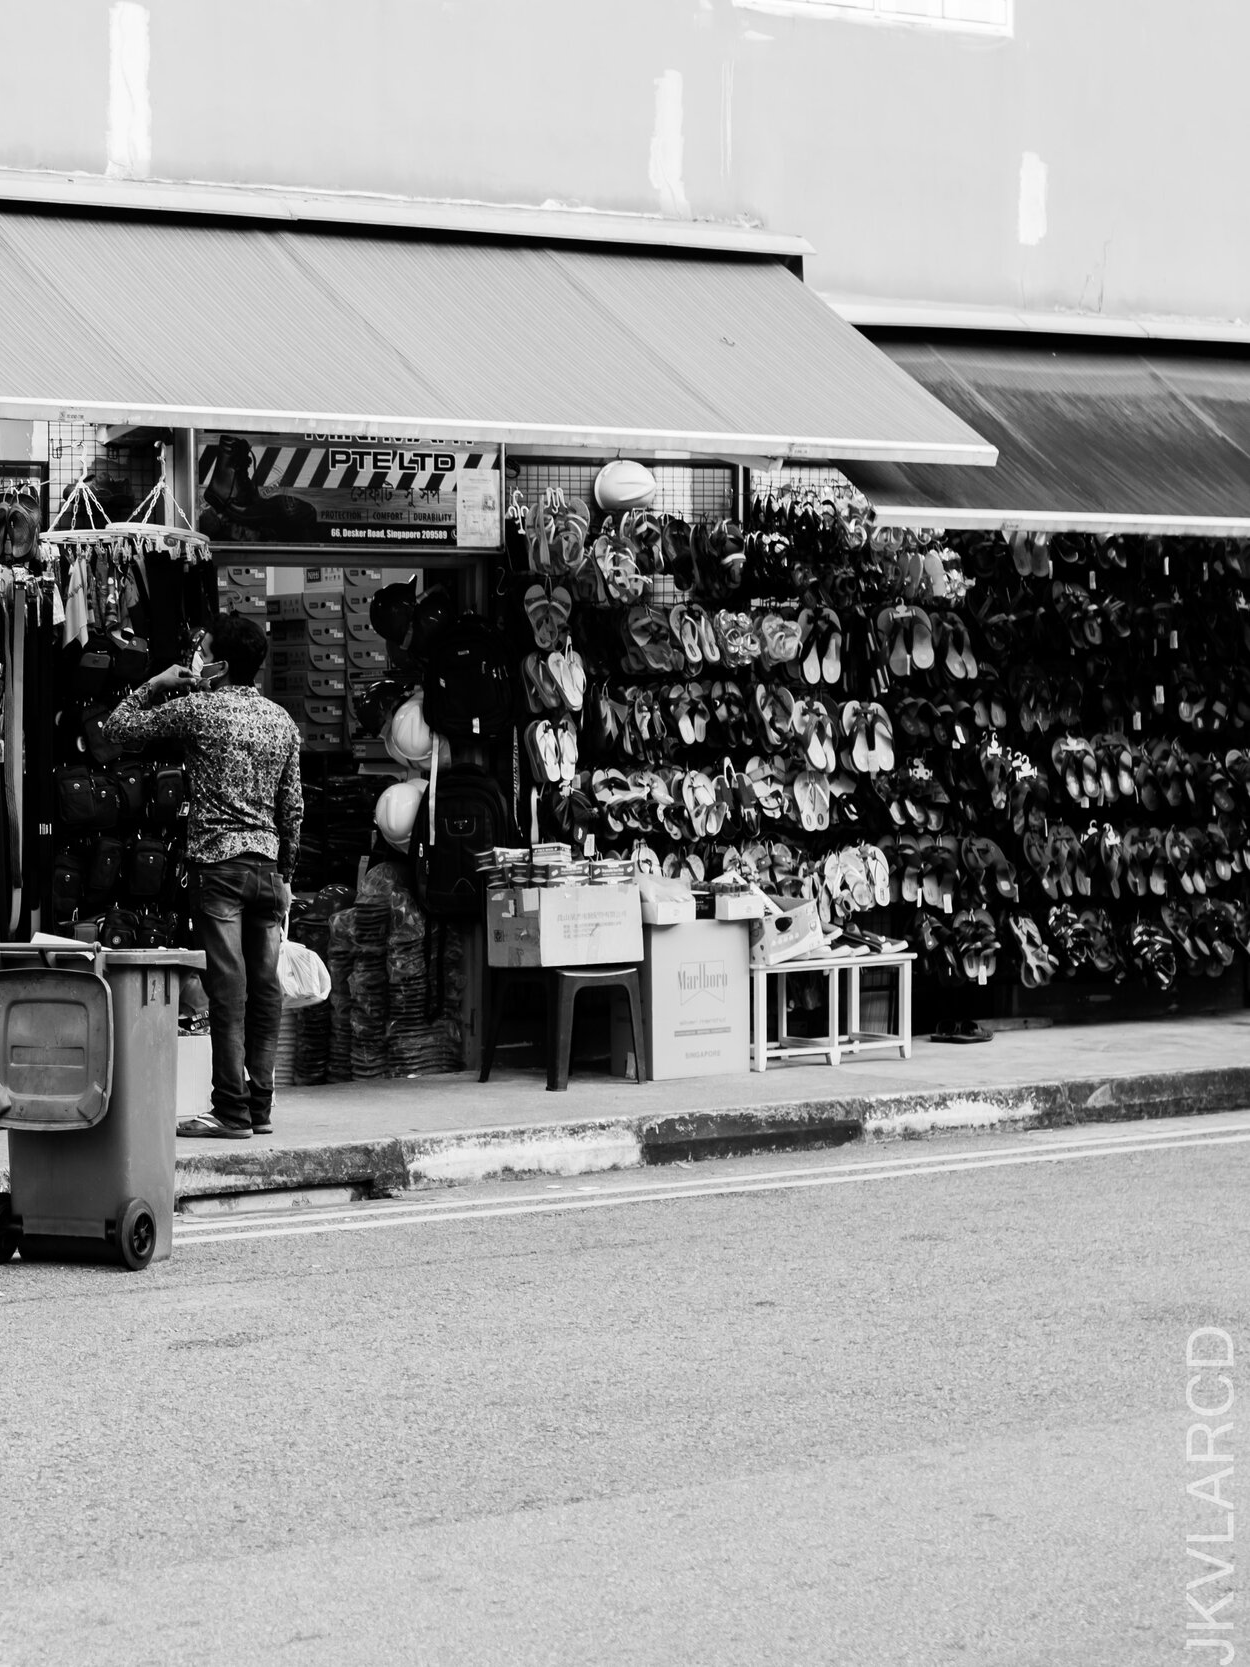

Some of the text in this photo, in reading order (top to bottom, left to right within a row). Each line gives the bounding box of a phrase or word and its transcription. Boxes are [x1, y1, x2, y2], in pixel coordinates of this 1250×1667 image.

[329, 449, 456, 473] PTE LTD
[320, 510, 452, 522] PROTECTION COMFORT DURABILITY
[342, 529, 366, 538] Desker
[367, 529, 386, 539] Road,
[386, 529, 421, 540] Singapore
[421, 530, 448, 539] 209589
[678, 963, 728, 990] Marlboro
[685, 1049, 720, 1060] SINGAPORE
